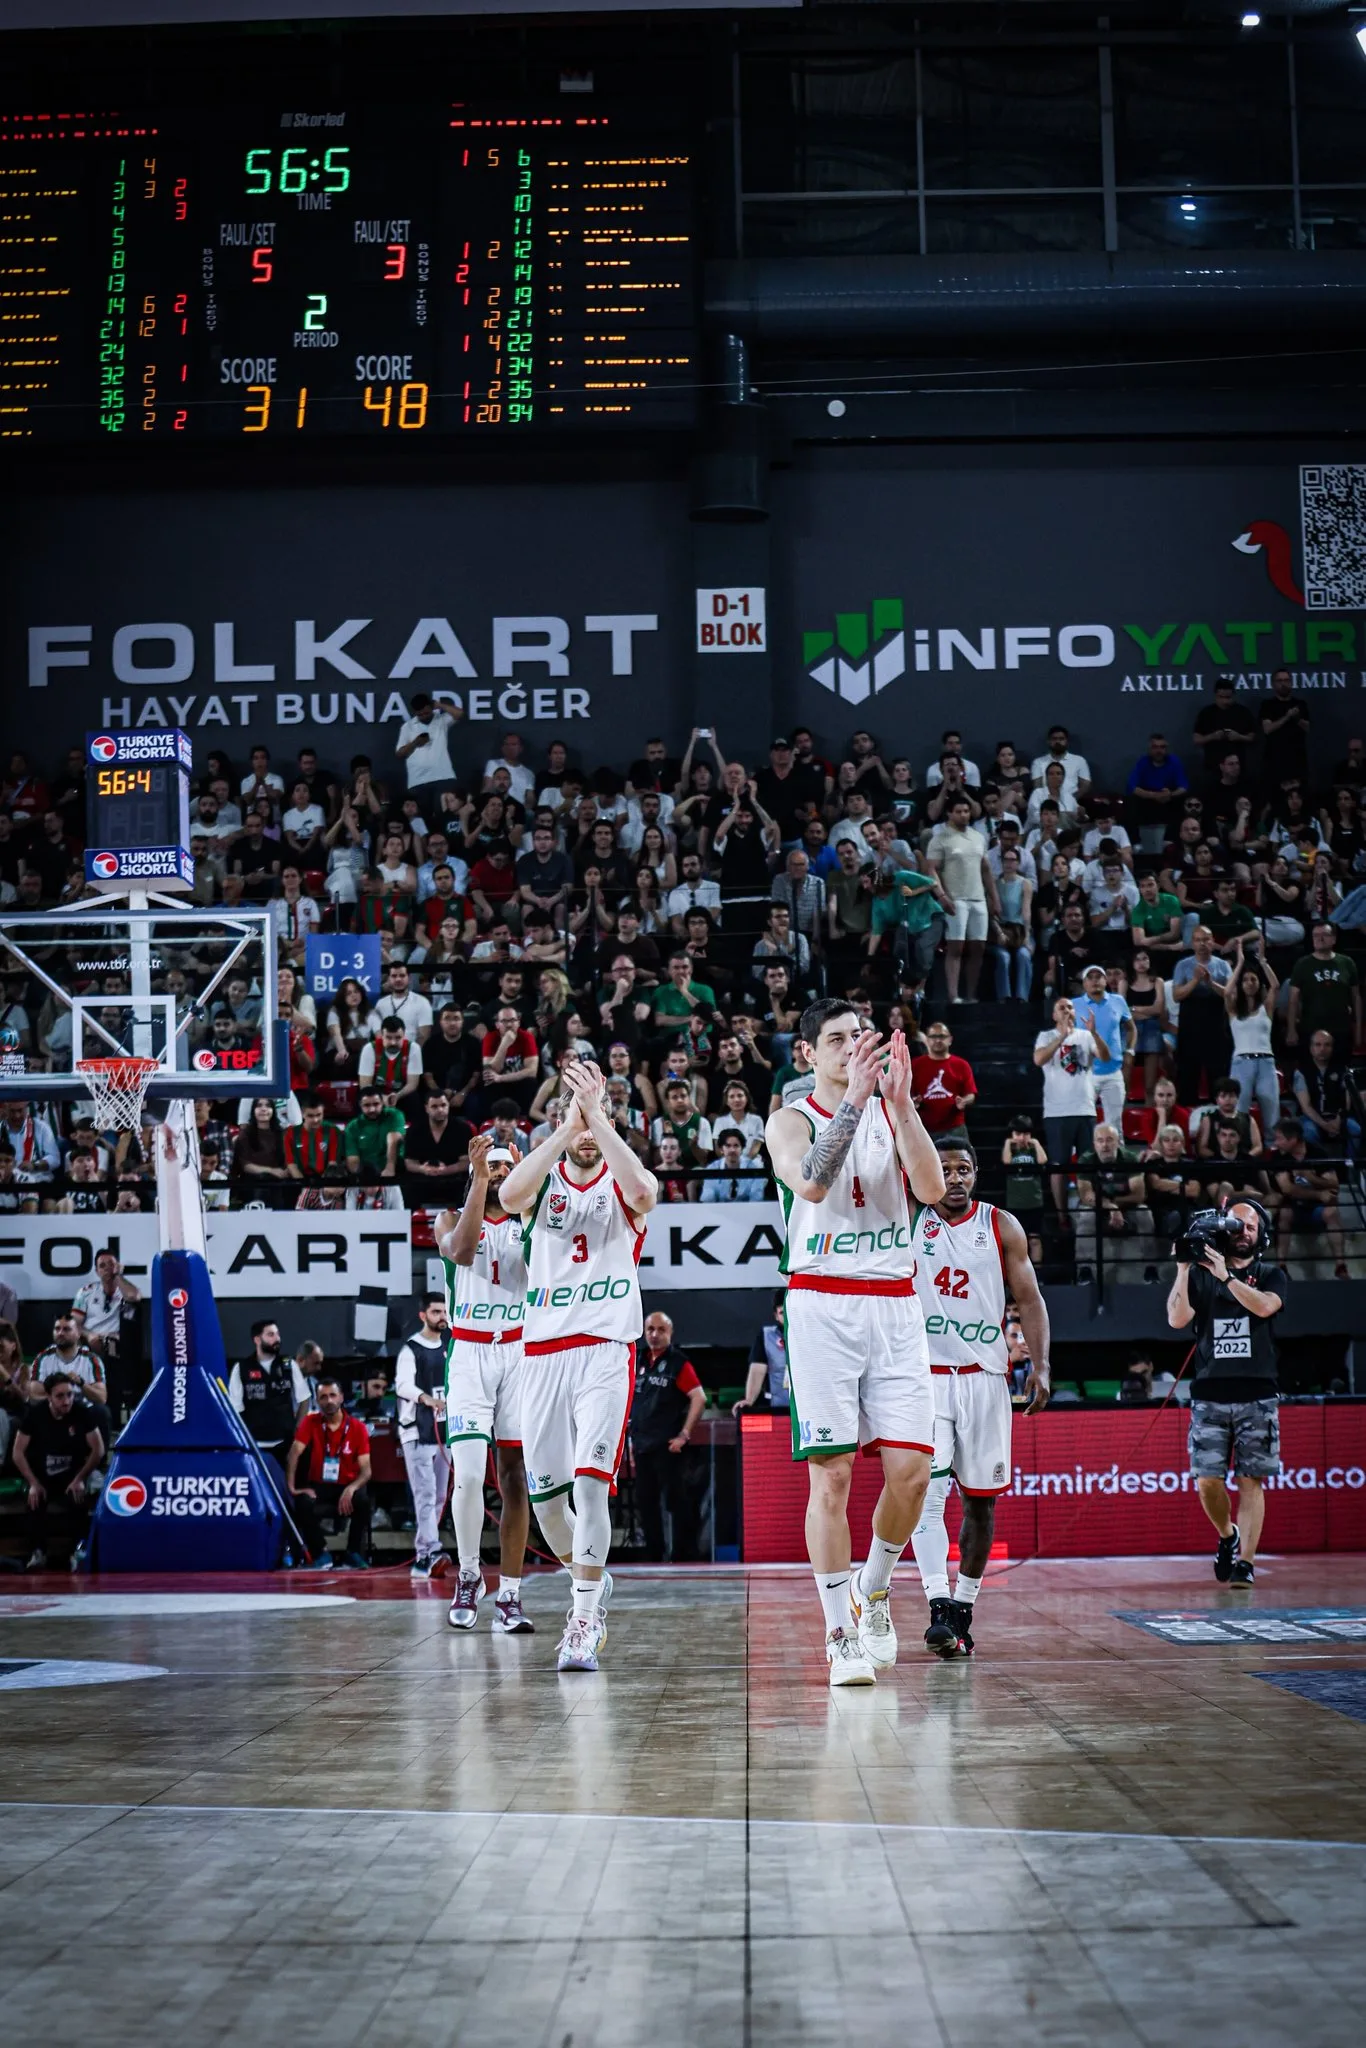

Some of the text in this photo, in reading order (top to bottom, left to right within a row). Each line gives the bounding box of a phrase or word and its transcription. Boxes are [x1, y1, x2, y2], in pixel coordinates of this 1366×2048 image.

[143, 158, 156, 174] 4
[487, 148, 500, 167] 5
[112, 178, 187, 200] 3 3 2
[518, 171, 532, 189] 3
[112, 201, 187, 222] 4 3
[296, 193, 332, 210] TIME
[513, 194, 532, 212] 10
[112, 227, 125, 246] 5
[219, 222, 276, 246] FAUL/SET
[354, 220, 411, 243] FAUL/SET
[487, 240, 501, 259] 2
[514, 240, 532, 259] 12
[203, 248, 214, 286] BONUS
[252, 247, 273, 283] 5
[384, 245, 406, 280] 3
[417, 243, 429, 281] BONUS
[455, 264, 533, 283] 2 14
[143, 295, 156, 314] 6
[174, 294, 187, 313] 2
[487, 287, 501, 306] 2
[514, 286, 533, 306] 19
[304, 294, 327, 330] 2
[139, 318, 156, 337] 12
[293, 332, 339, 347] PERIOD
[487, 334, 501, 352] 4
[506, 333, 533, 352] 22
[100, 366, 125, 385] 32
[143, 365, 156, 384] 2
[220, 358, 277, 383] SCORE
[355, 355, 413, 381] SCORE
[507, 357, 533, 376] 34
[100, 388, 156, 409] 35 2
[487, 381, 501, 399] 2
[507, 380, 533, 399] 35
[242, 385, 307, 432] 31
[364, 383, 428, 428] 48
[476, 404, 502, 423] 20
[507, 404, 533, 423] 94
[100, 410, 187, 431] 42 2 2
[712, 594, 750, 616] D-1
[701, 623, 763, 646] BLOK
[28, 614, 658, 687] FOLKART
[1121, 674, 1204, 692] AKILLI
[102, 695, 258, 728] HAYAT
[276, 692, 408, 725] BUNA
[98, 769, 151, 796] 56:4
[320, 952, 335, 969] D
[353, 952, 365, 969] 3
[313, 975, 372, 993] BLK
[216, 1050, 260, 1069] TBF
[572, 1233, 588, 1263] 3
[491, 1260, 500, 1285] 1
[934, 1266, 969, 1300] 42
[552, 1276, 631, 1307] endo
[472, 1301, 526, 1321] end
[926, 1315, 1000, 1344] endo
[1215, 1342, 1249, 1355] 2022
